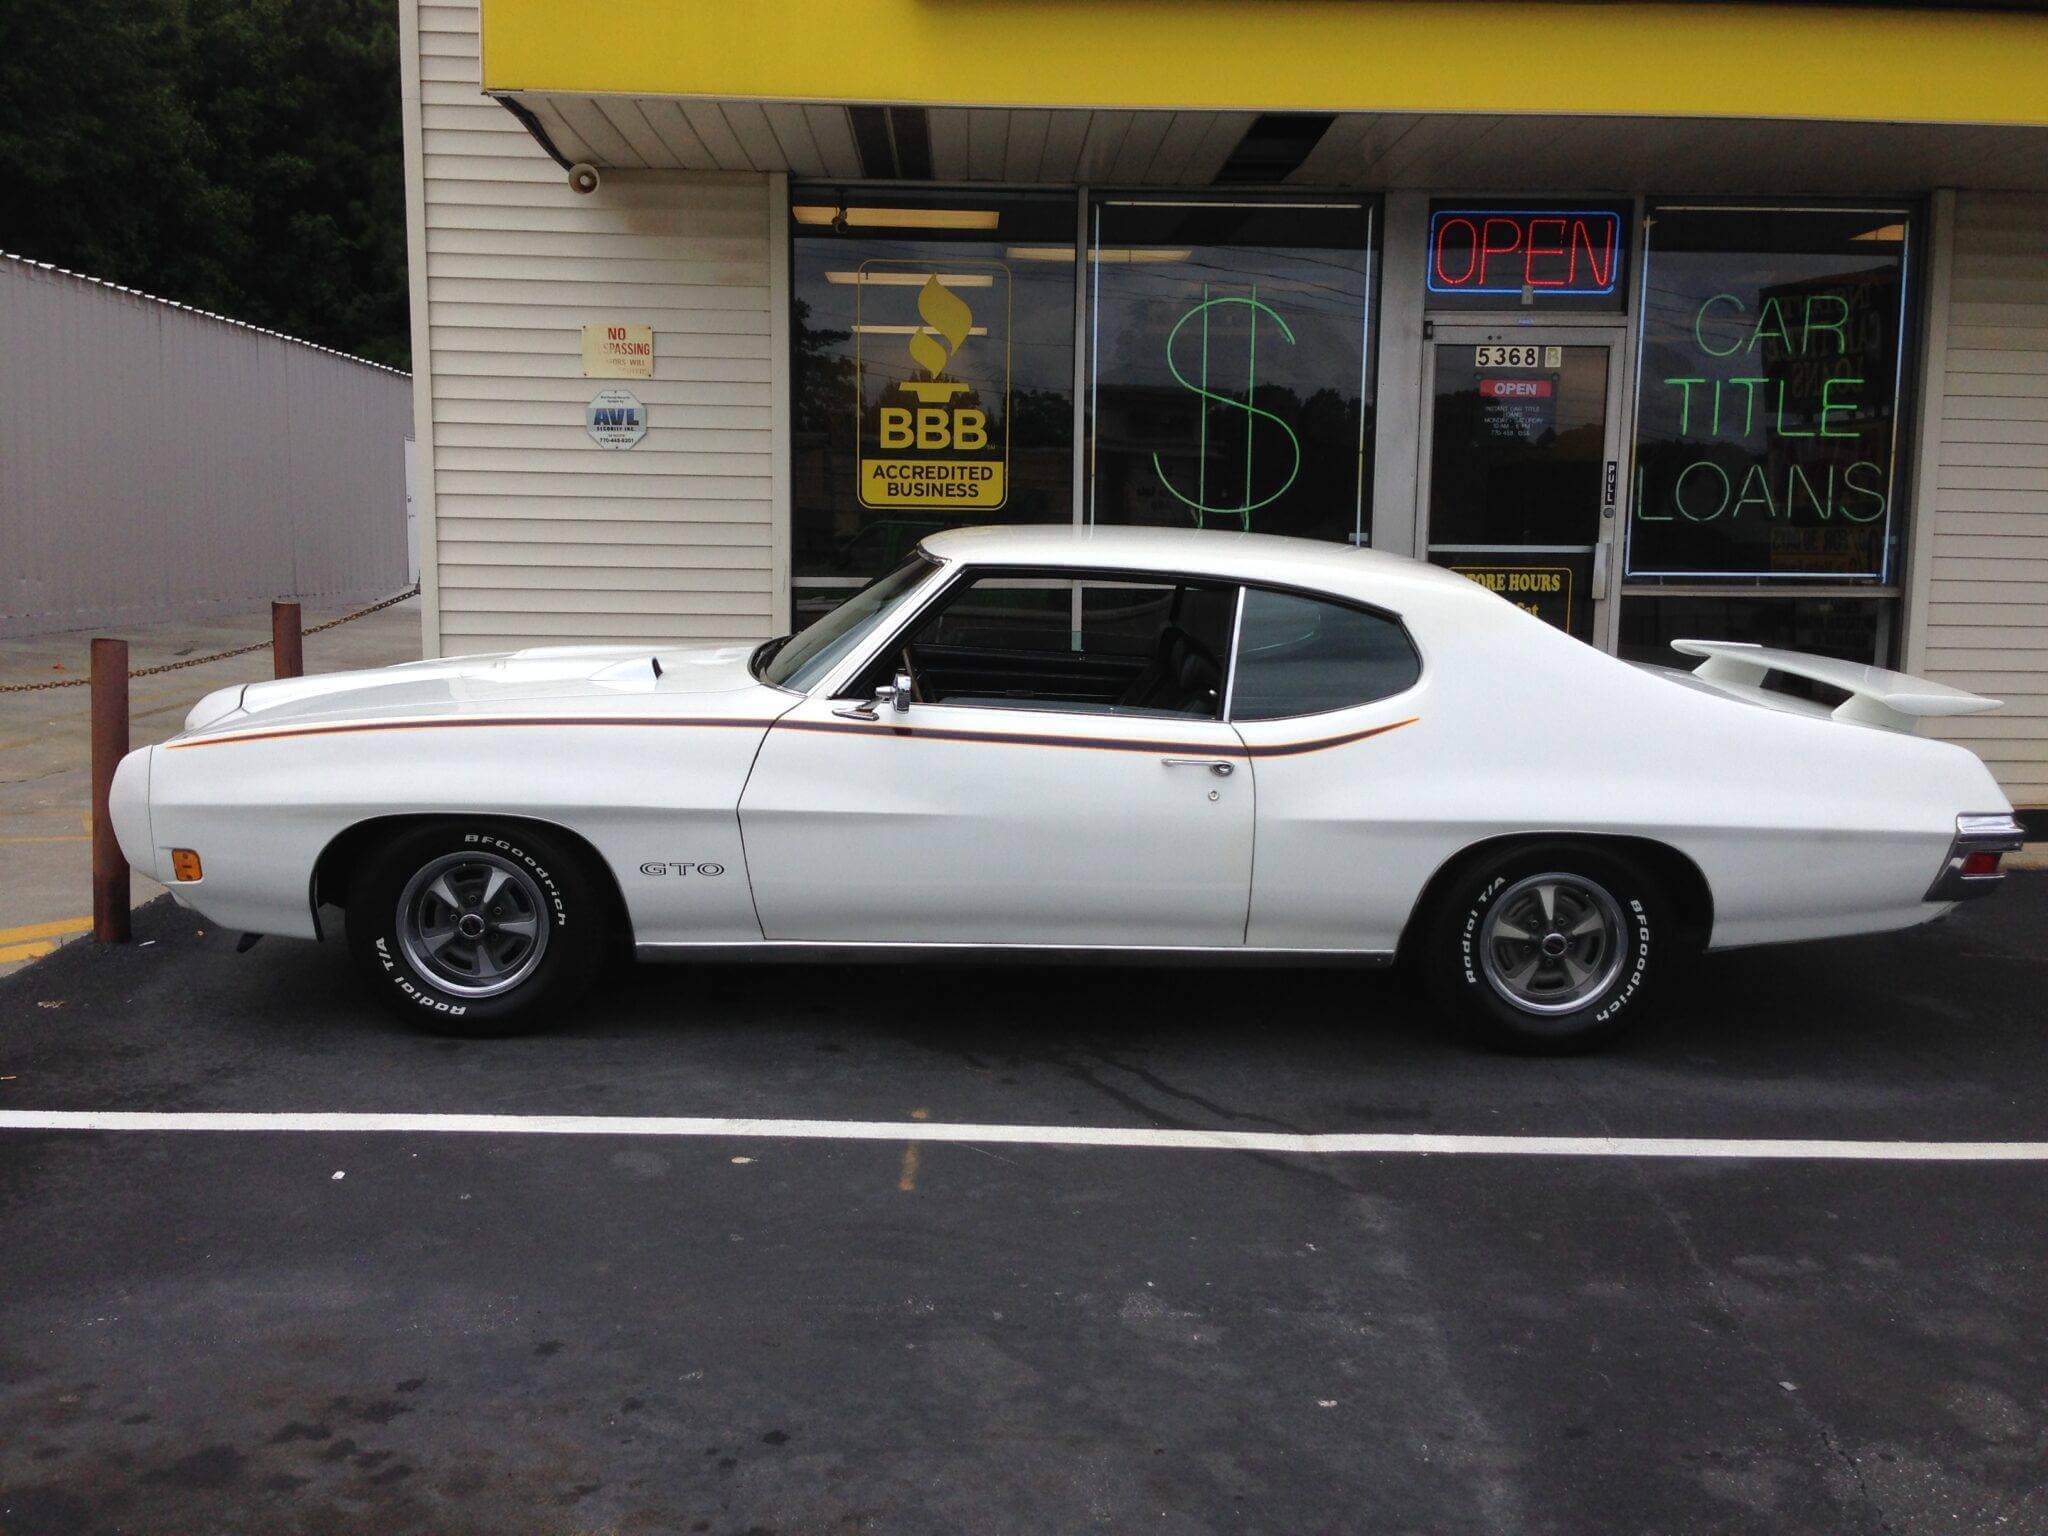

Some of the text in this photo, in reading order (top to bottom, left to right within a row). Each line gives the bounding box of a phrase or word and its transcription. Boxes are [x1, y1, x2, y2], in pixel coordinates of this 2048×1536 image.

[1437, 218, 1612, 286] OPEN
[607, 327, 626, 341] NO
[1696, 294, 1848, 356] CAR
[1477, 348, 1536, 366] 5368
[1153, 284, 1300, 531] $
[1494, 382, 1537, 395] OPEN
[1664, 378, 1866, 438] TITLE
[593, 408, 640, 426] AVL
[880, 408, 988, 450] BBB
[873, 465, 994, 480] ACCREDITED
[887, 482, 980, 498] BUSINESS
[1607, 464, 1616, 502] PULL
[1638, 461, 1886, 523] LOANS
[1465, 573, 1561, 592] TORE HOURS
[464, 834, 567, 927] BFGoodrich
[639, 861, 725, 877] GTO
[1462, 877, 1506, 983] Radial T/A
[375, 937, 467, 1015] Radial T/A
[1596, 899, 1650, 1021] BFGoodrich
